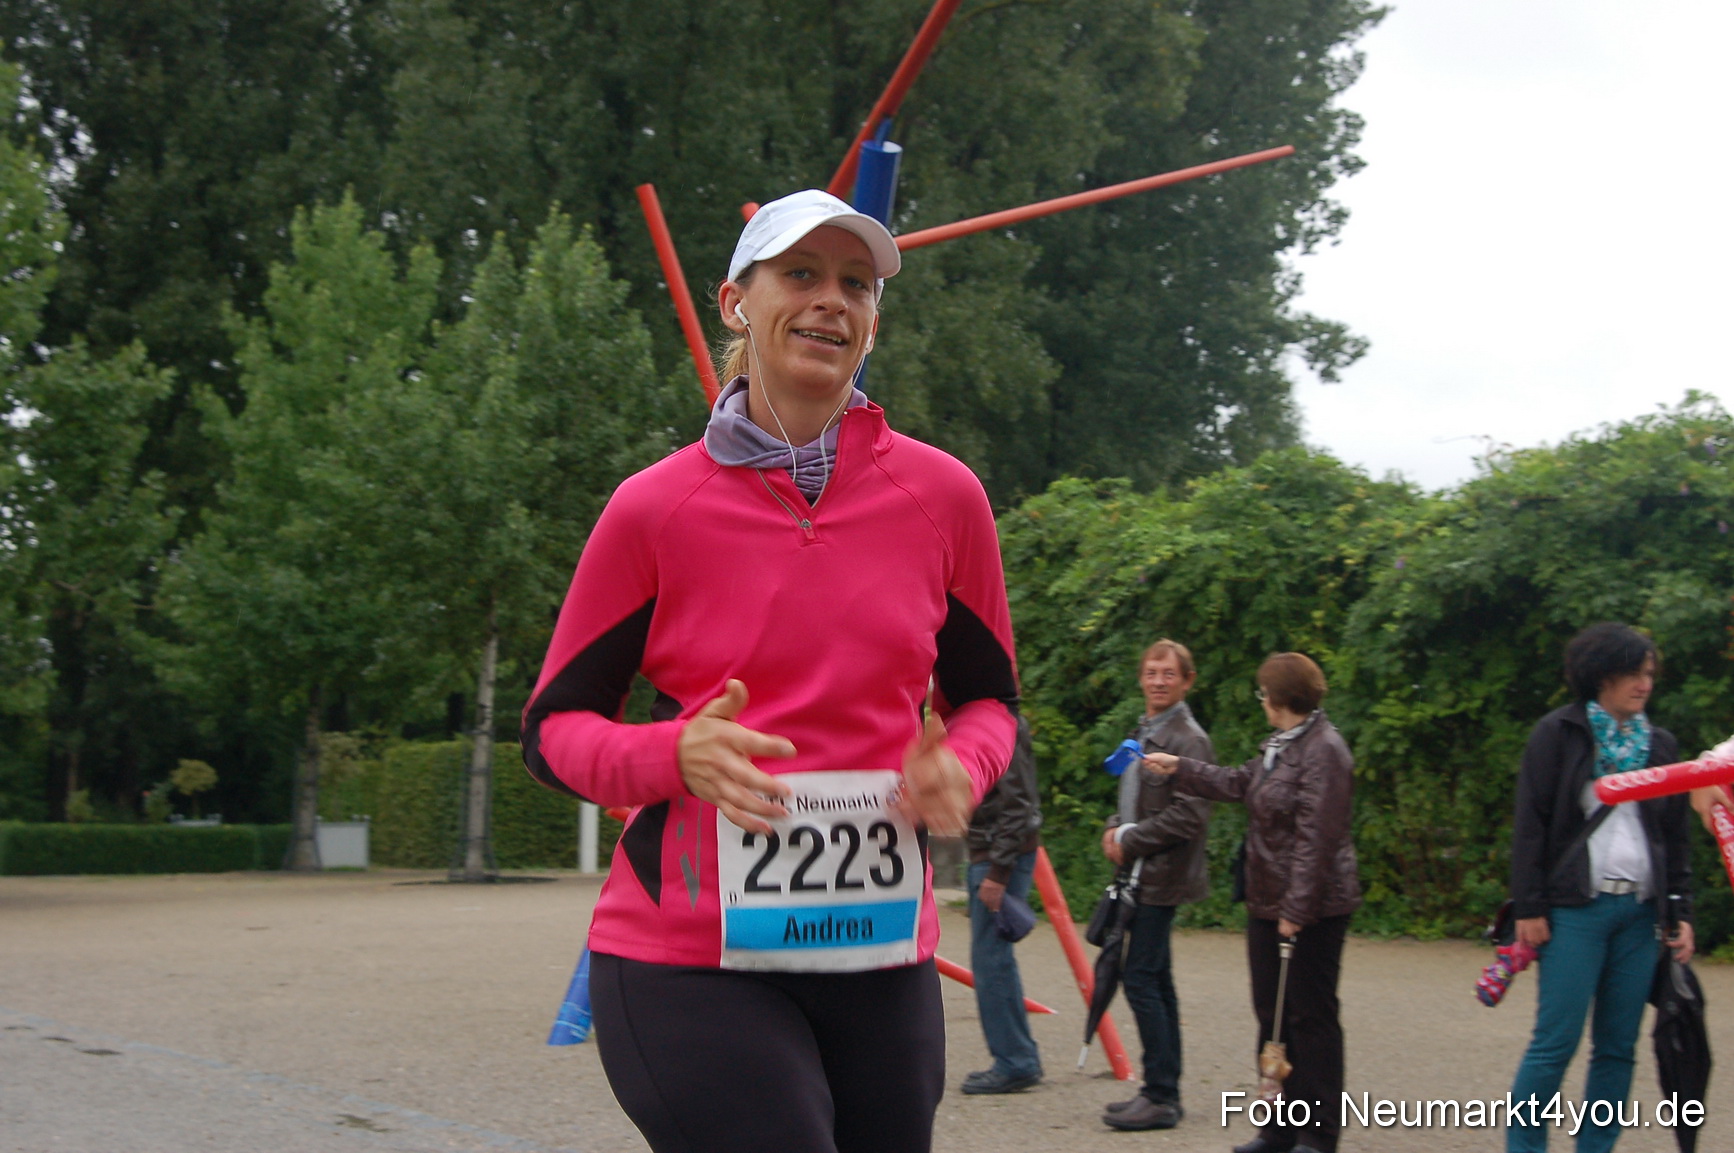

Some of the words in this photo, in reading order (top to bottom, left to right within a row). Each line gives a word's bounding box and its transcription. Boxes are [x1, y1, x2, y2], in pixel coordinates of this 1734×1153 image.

[796, 791, 880, 813] Neumarkt
[742, 821, 904, 894] 2223
[783, 914, 874, 945] Andrea
